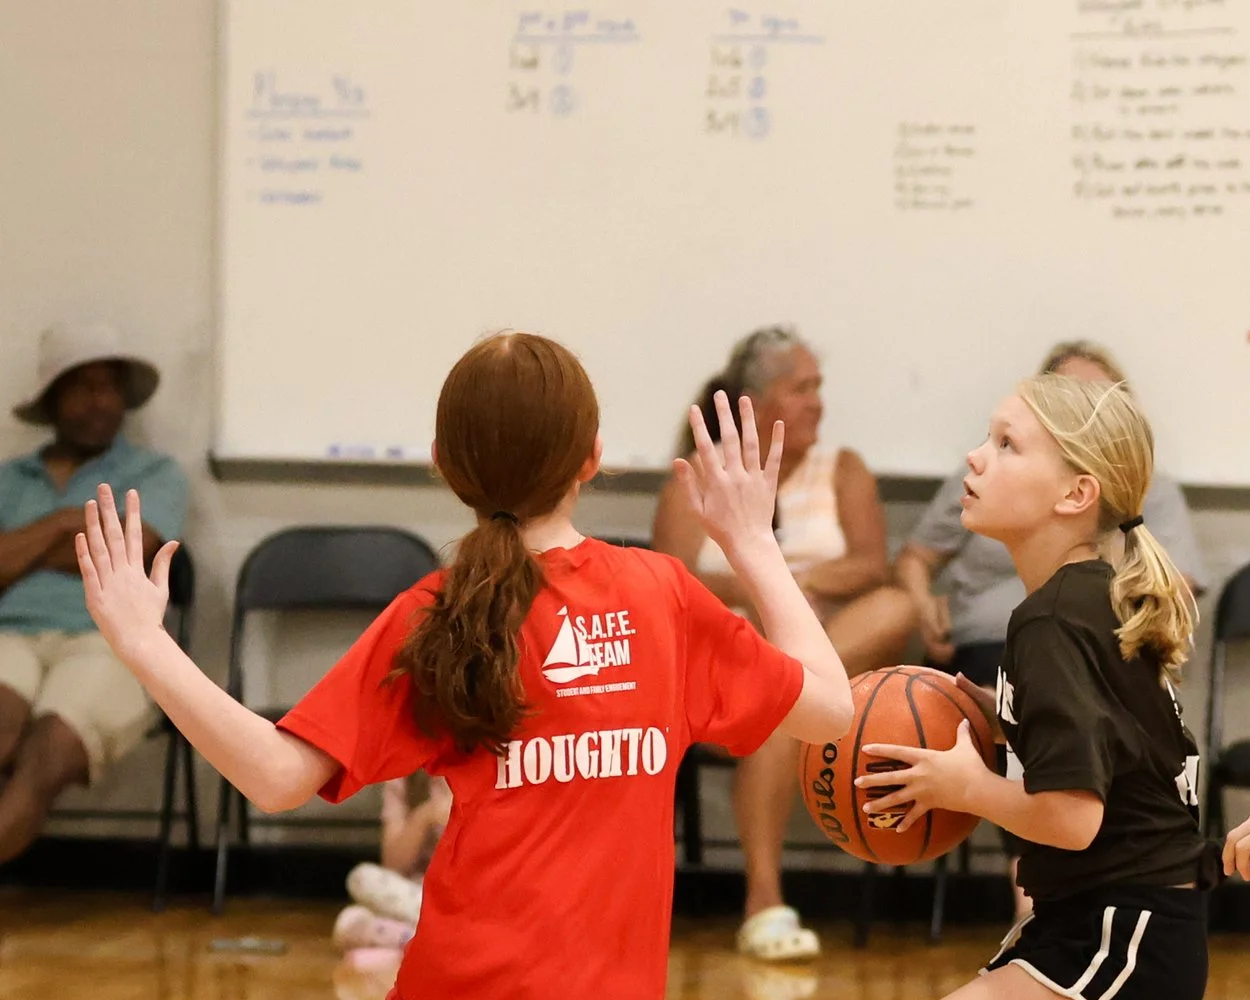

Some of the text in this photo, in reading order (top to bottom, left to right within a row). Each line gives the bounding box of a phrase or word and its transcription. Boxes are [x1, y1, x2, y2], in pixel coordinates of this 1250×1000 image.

[575, 610, 636, 640] S.A.F.E.
[586, 639, 631, 668] TEAM
[495, 727, 669, 789] HOUGHTO
[813, 738, 849, 842] Wilso
